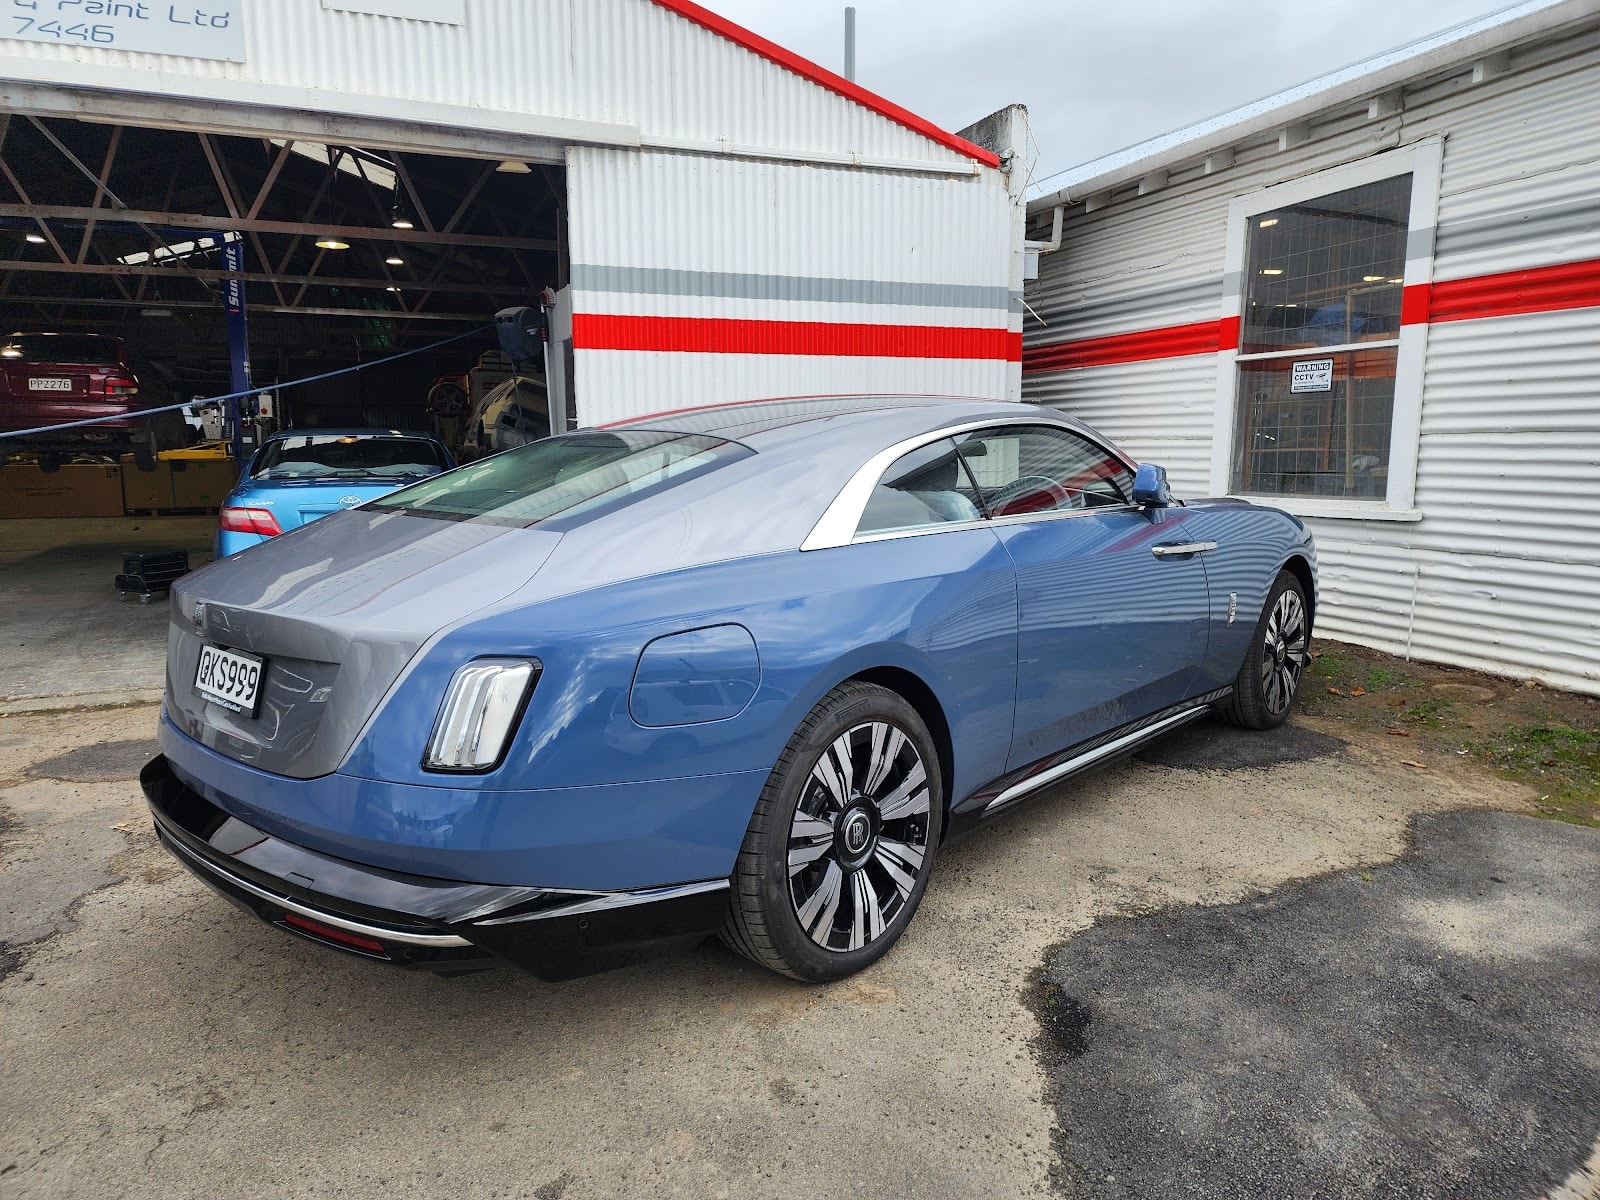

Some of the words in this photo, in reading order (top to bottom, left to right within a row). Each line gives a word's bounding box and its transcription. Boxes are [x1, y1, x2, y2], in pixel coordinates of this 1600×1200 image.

[168, 5, 230, 29] Ltd
[12, 16, 115, 43] 7446
[1296, 363, 1330, 372] WARNING
[30, 380, 70, 389] PPZ276
[1294, 373, 1314, 381] CCTV
[200, 651, 258, 701] QKS999
